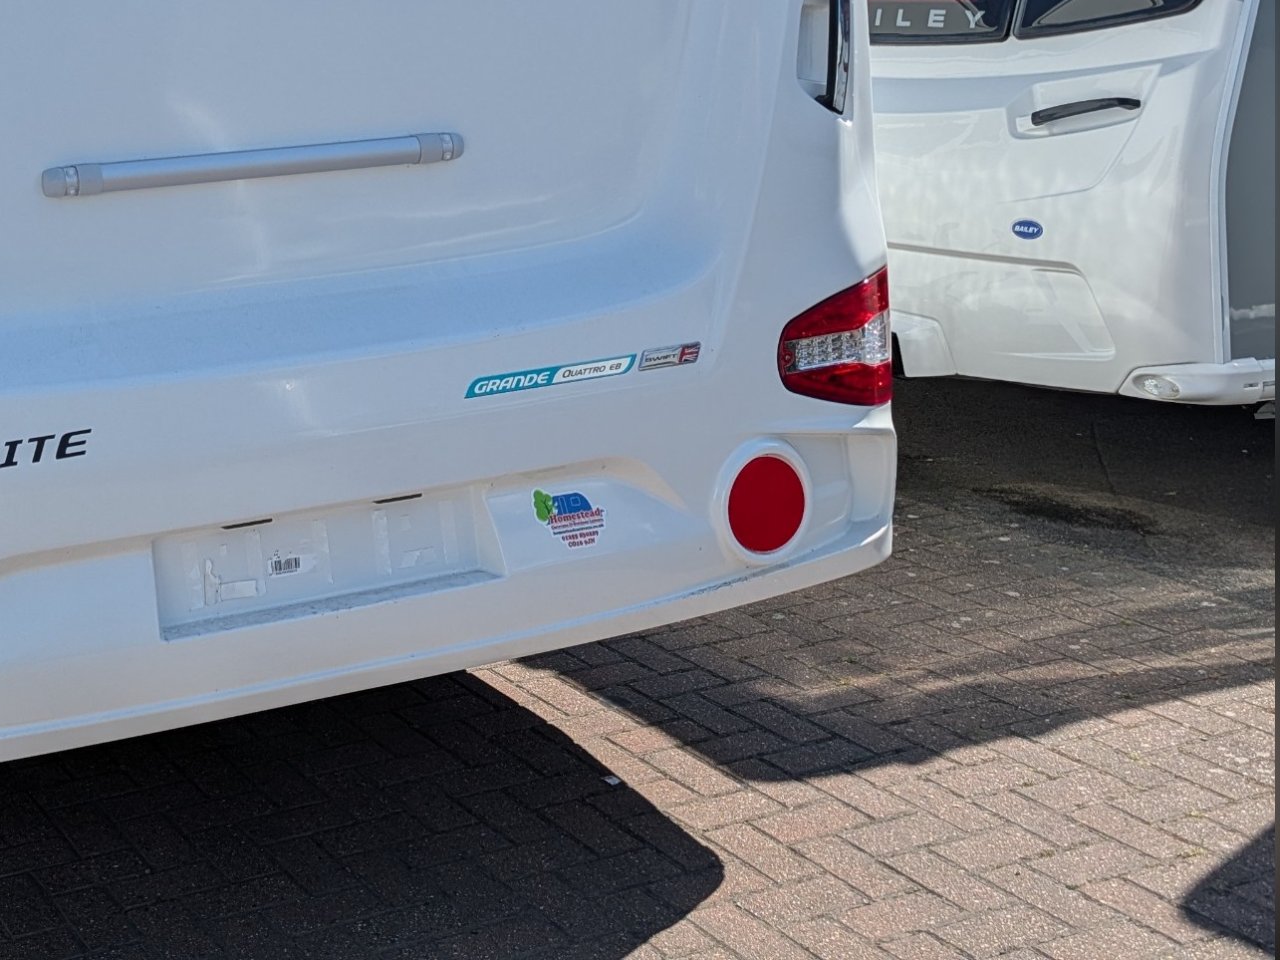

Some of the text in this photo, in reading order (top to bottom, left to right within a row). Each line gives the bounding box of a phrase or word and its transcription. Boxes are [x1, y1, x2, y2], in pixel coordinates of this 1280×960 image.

[874, 8, 986, 29] ILEY
[1014, 225, 1039, 234] BAILEY
[645, 353, 678, 363] SWIFT
[474, 371, 551, 394] GRANDE
[550, 507, 600, 523] Homestead
